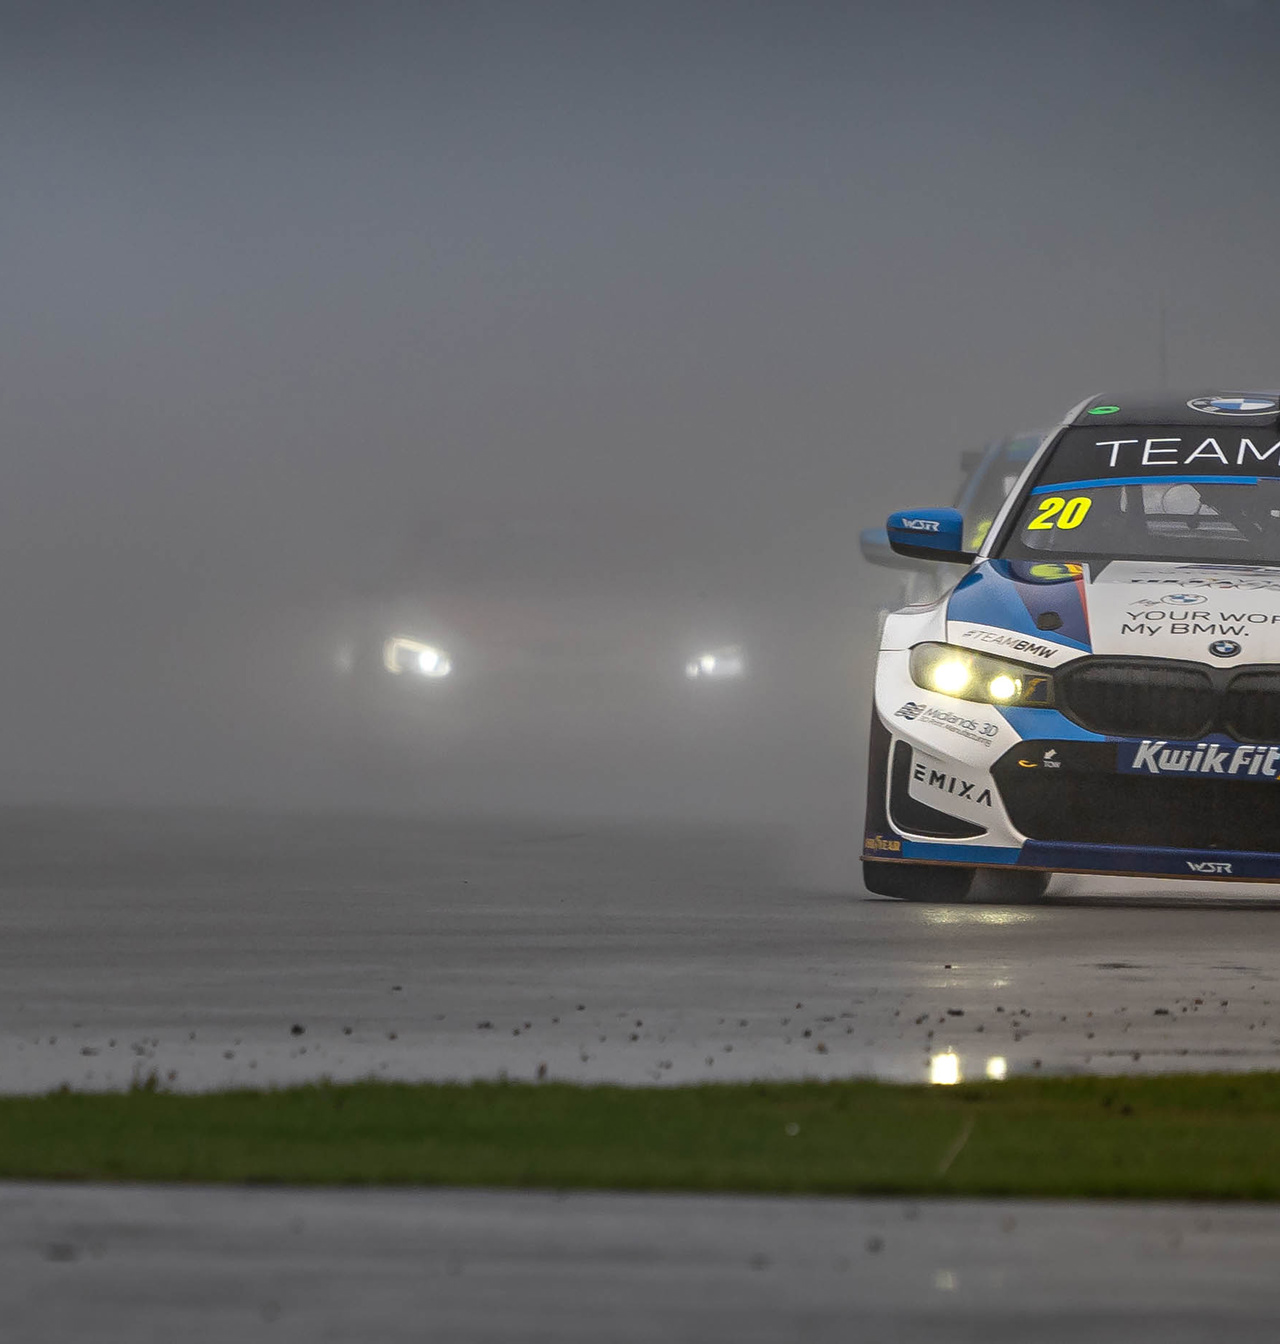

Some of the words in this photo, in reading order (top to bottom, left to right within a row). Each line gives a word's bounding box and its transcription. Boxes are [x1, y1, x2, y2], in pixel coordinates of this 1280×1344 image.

[1027, 496, 1092, 530] 20
[901, 518, 940, 532] WSR
[1126, 610, 1211, 621] YOUR
[1121, 623, 1162, 636] My
[1170, 623, 1249, 636] BMW.
[979, 722, 999, 737] 3D
[913, 763, 992, 807] EMIXA
[1186, 861, 1233, 873] WSR
